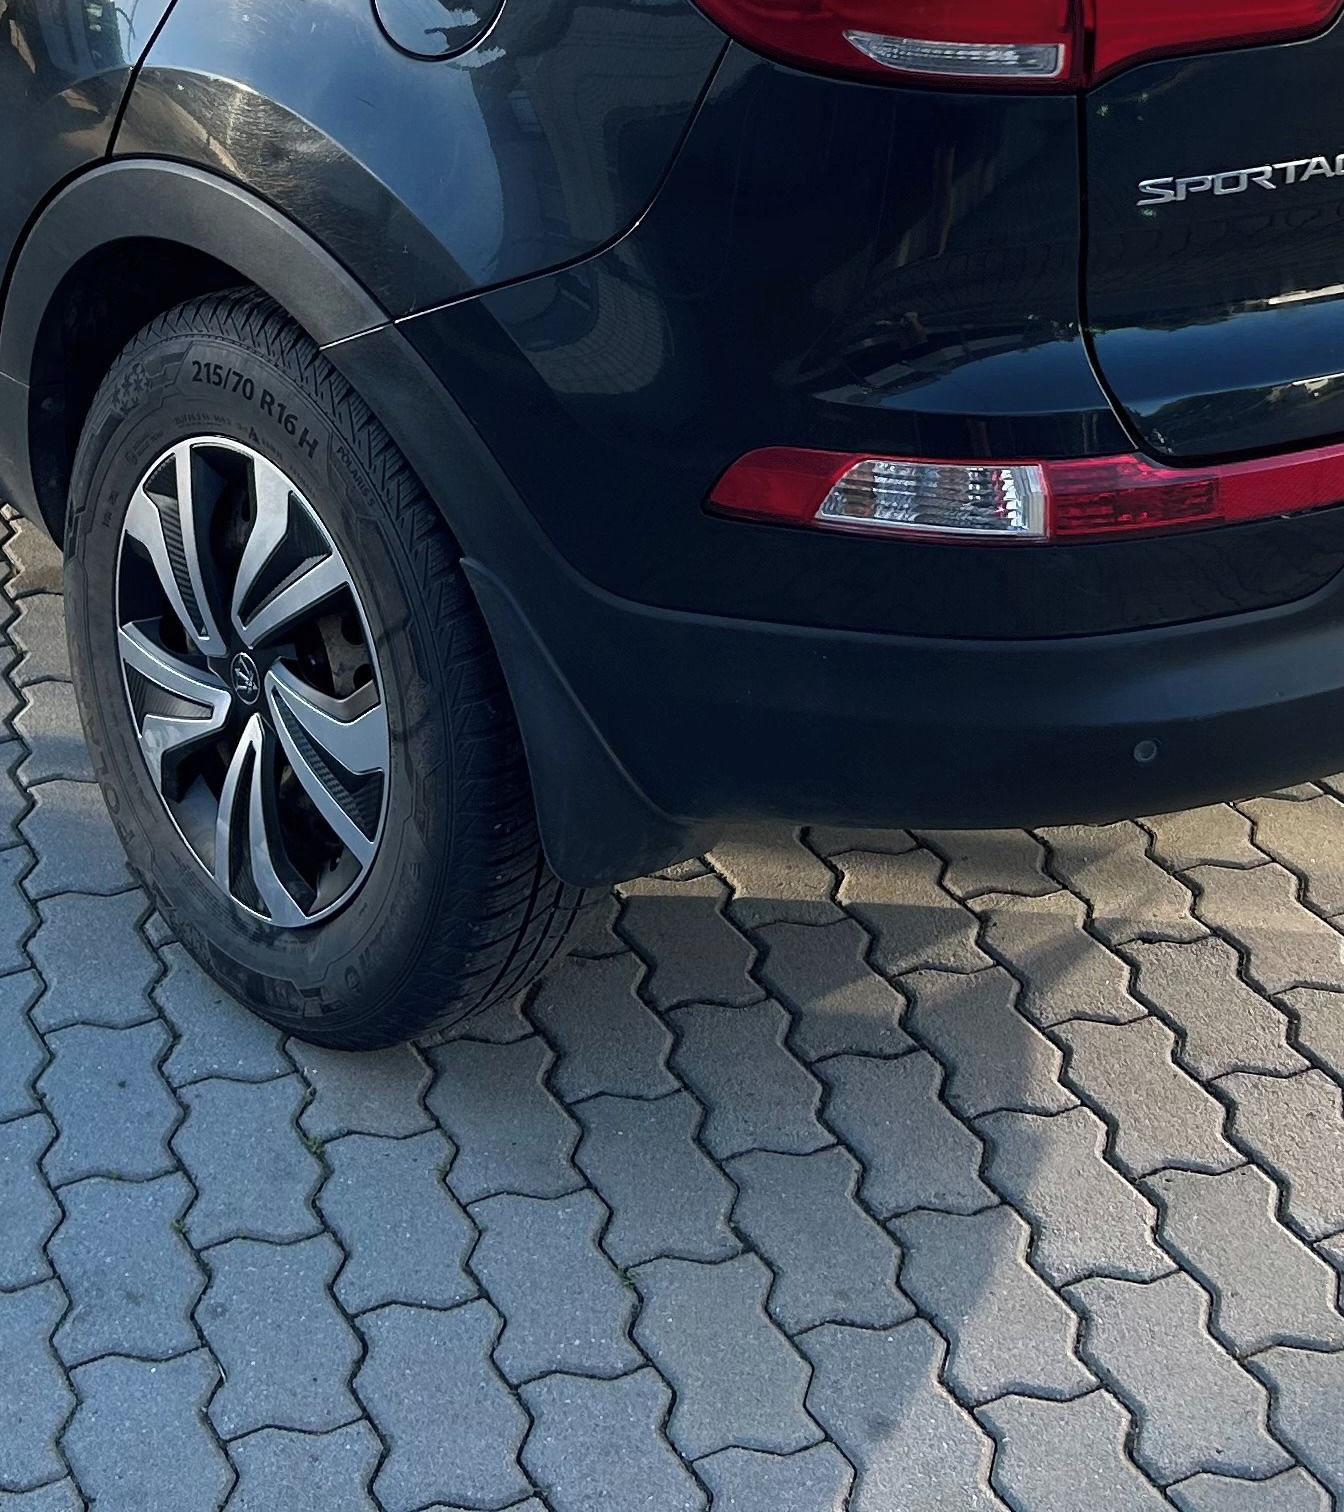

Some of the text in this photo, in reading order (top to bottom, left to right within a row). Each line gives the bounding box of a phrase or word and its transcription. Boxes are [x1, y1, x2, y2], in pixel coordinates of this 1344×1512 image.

[191, 360, 255, 401] 215/70
[259, 387, 299, 436] R16
[298, 426, 320, 459] H
